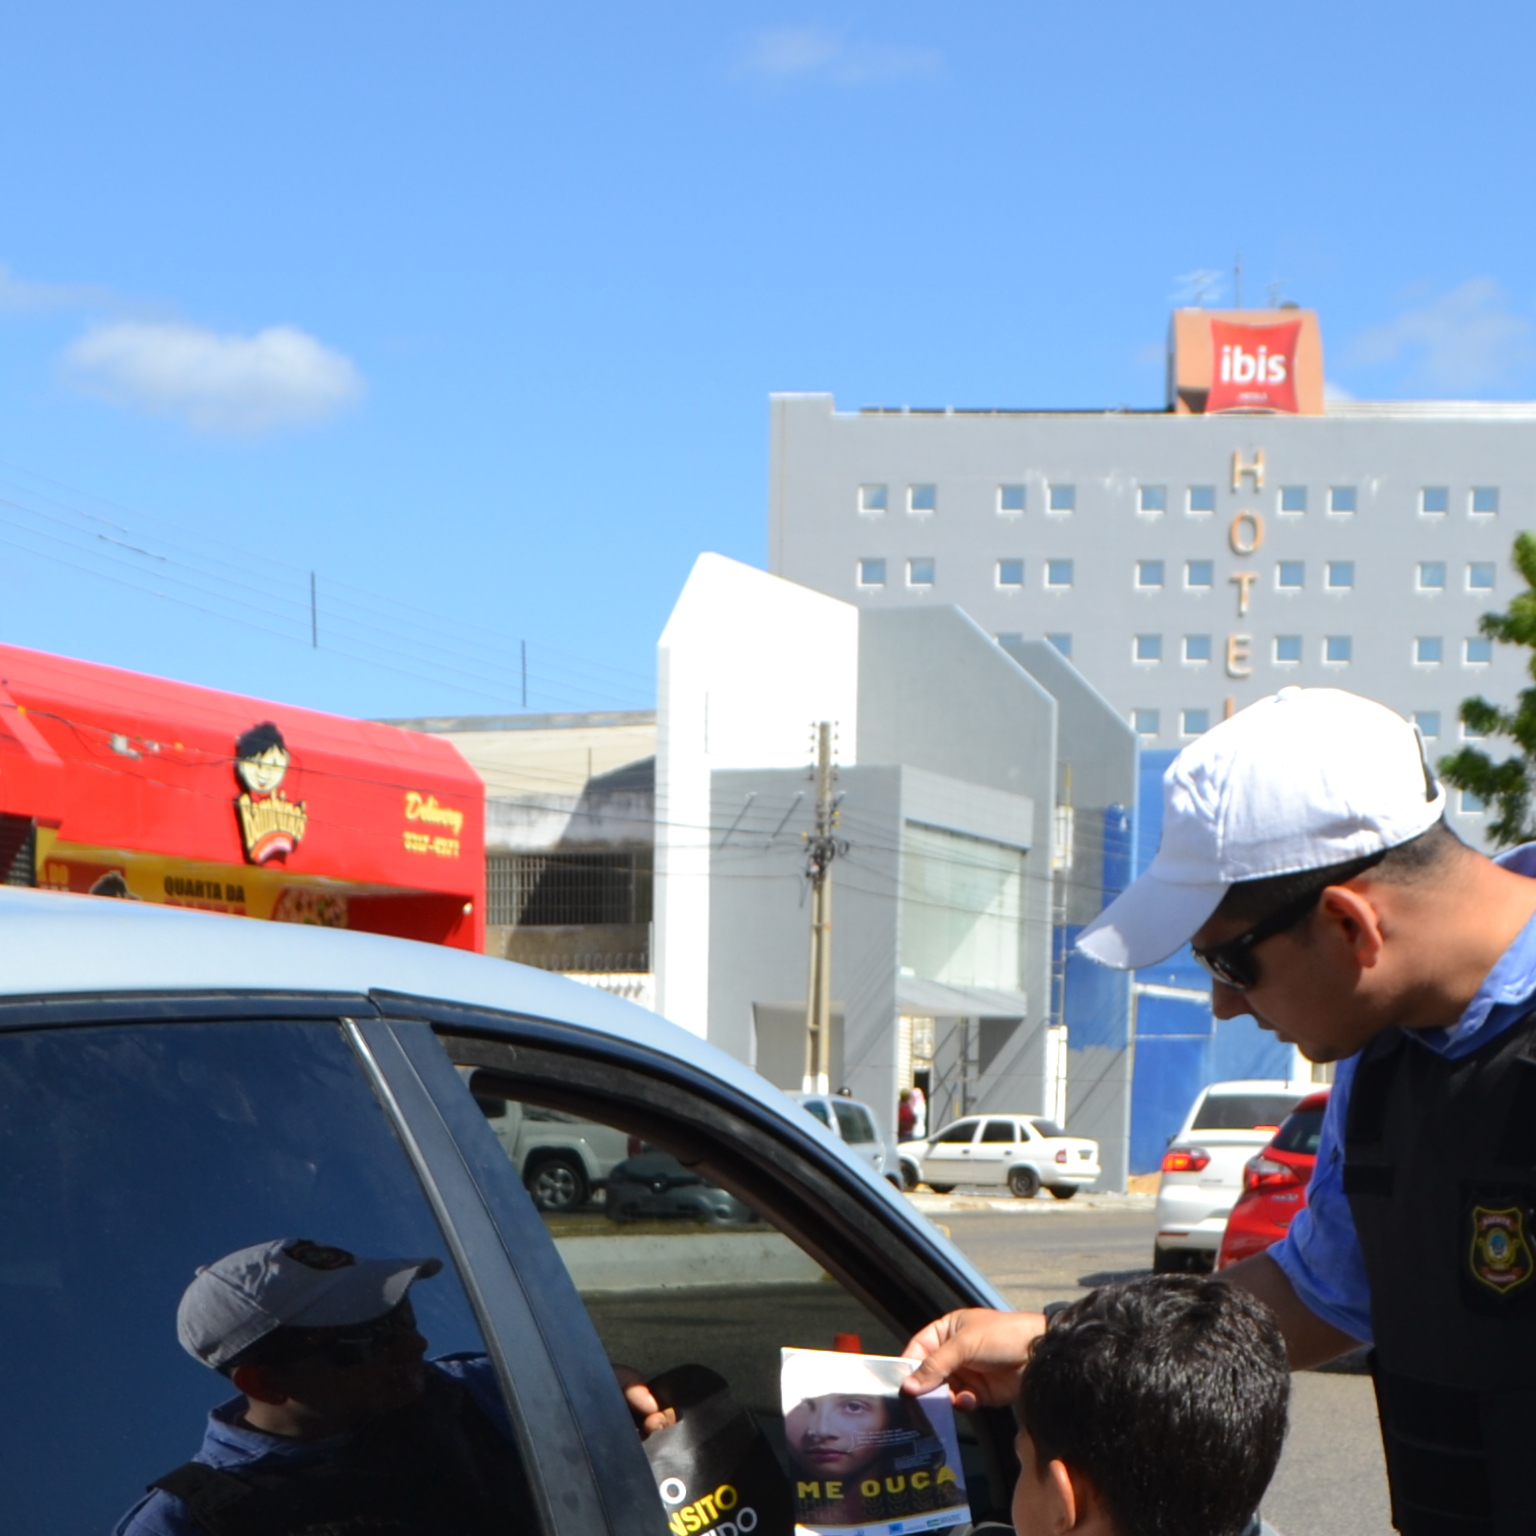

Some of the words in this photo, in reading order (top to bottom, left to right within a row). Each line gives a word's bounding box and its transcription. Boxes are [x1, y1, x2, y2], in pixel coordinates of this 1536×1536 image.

[1221, 344, 1287, 384] ibis
[165, 876, 222, 901] QUARTA
[226, 884, 245, 903] DA
[796, 1480, 844, 1499] ME
